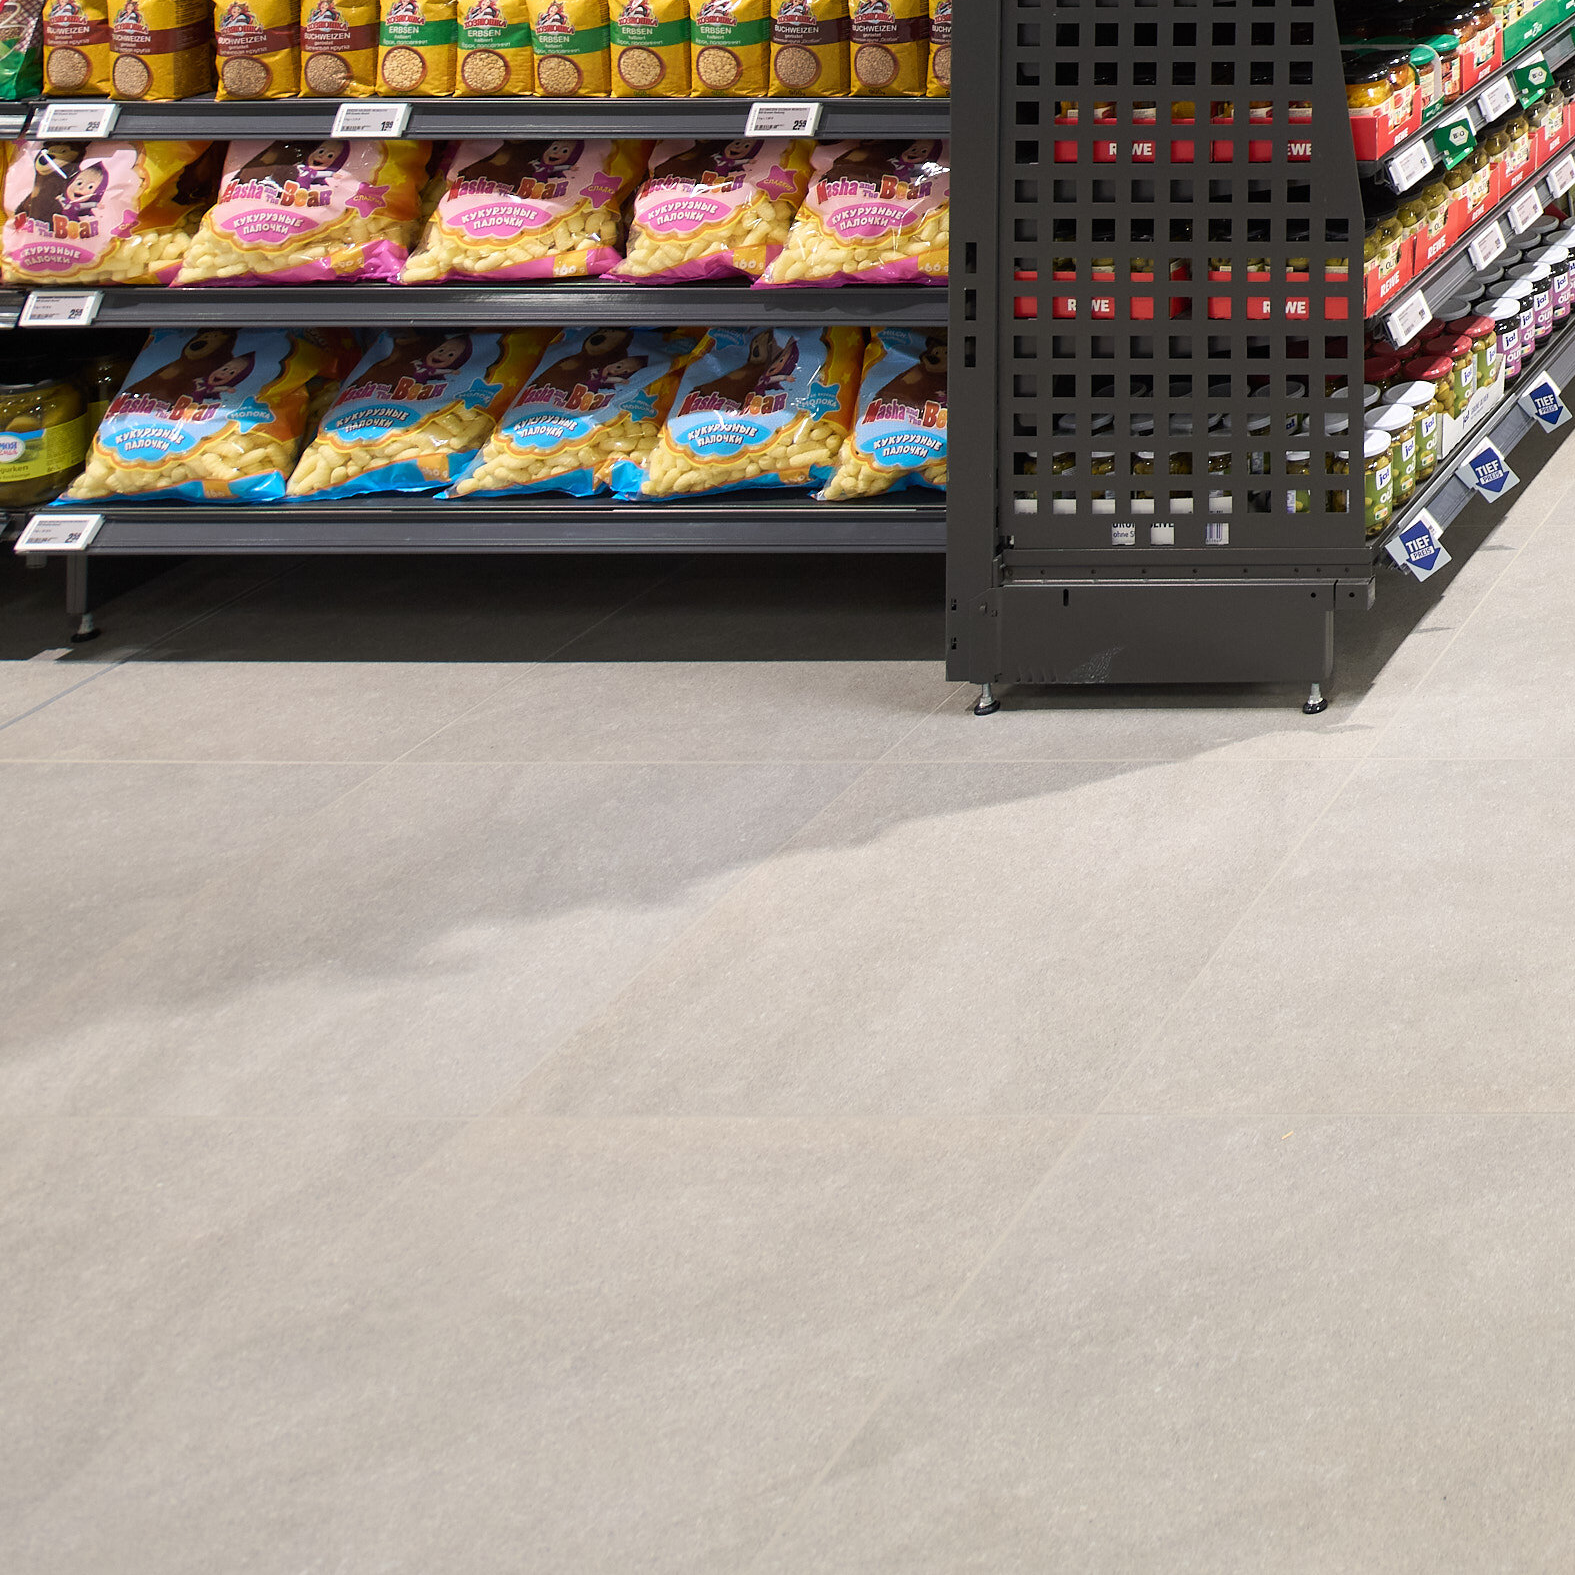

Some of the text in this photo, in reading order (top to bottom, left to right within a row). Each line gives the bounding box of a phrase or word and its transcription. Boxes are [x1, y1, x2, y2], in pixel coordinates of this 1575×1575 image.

[388, 25, 420, 35] ERBSEN
[467, 28, 501, 37] ERBSEN
[851, 25, 898, 35] BUCHWEIZEN
[648, 202, 718, 220] КУКУРУЗНЫЕ
[656, 211, 705, 226] ПАЛОЧКИ
[233, 213, 304, 228] КУКУРУЗНЫЕ
[243, 223, 289, 235] ПАЛОЧКИ
[1427, 235, 1447, 258] REWE
[1380, 270, 1400, 296] REWE
[1534, 395, 1555, 407] TIEF
[124, 438, 172, 453] ПАЛОЧКИ
[1378, 467, 1391, 489] ja!
